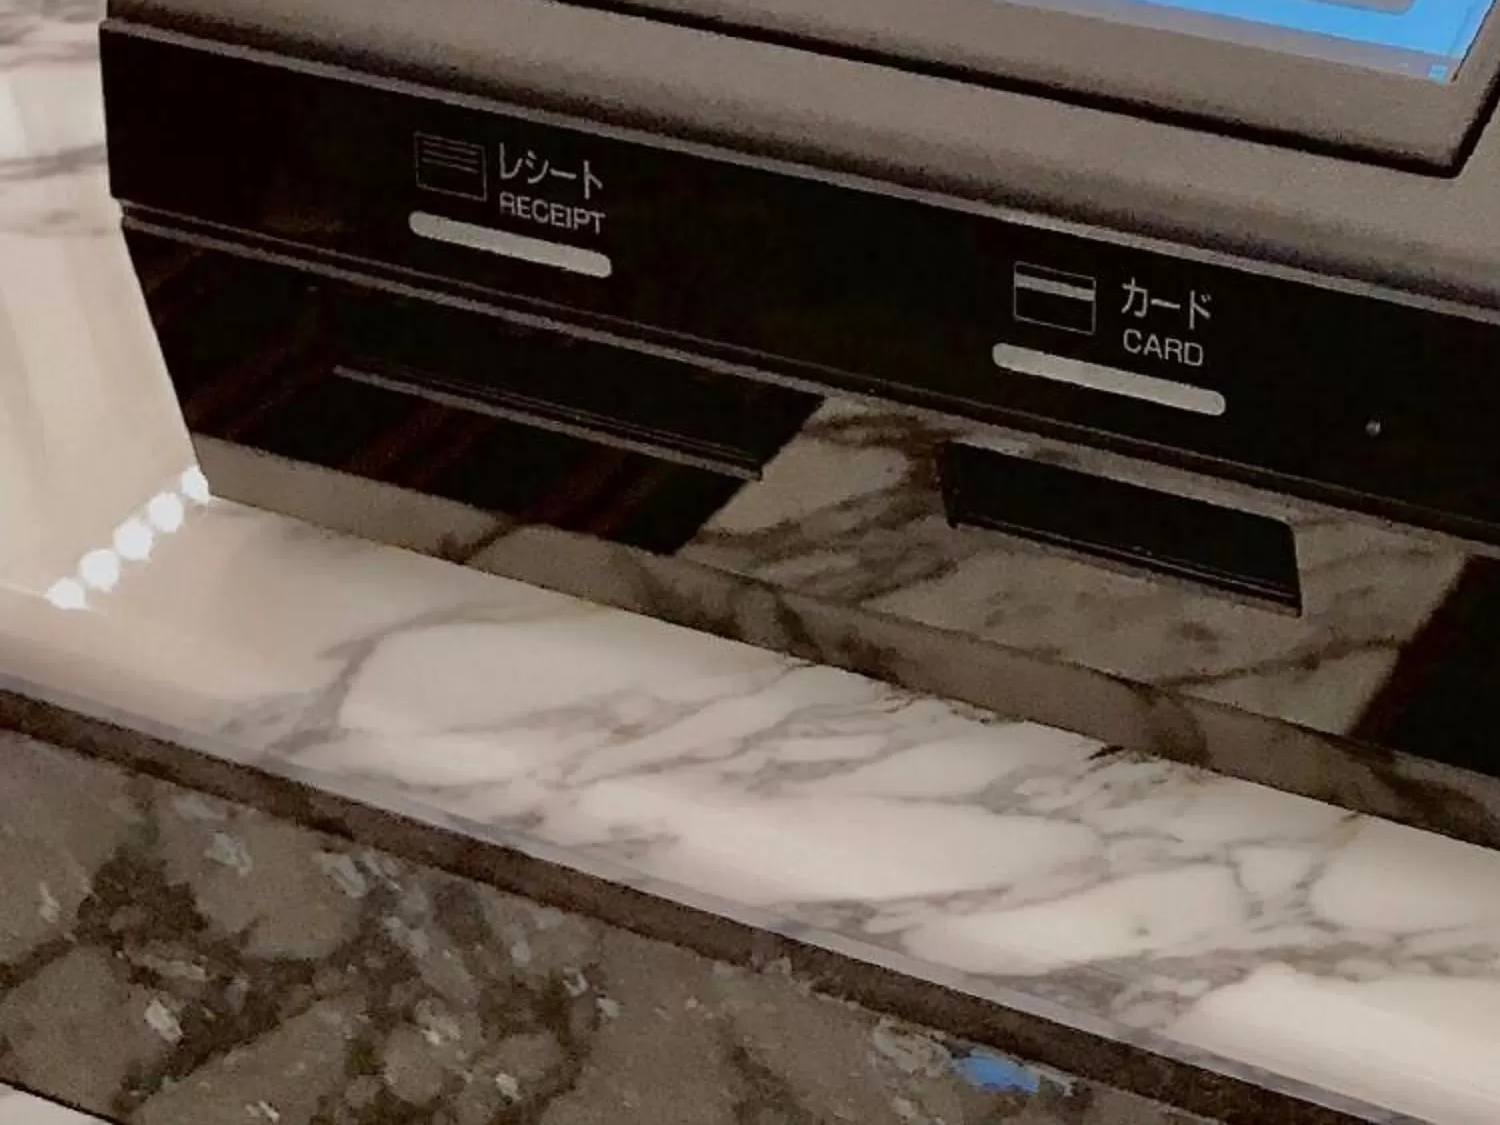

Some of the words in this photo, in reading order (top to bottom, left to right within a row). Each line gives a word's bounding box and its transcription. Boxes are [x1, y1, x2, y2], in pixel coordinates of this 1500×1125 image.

[499, 141, 604, 201] レシート
[499, 190, 607, 235] RECEIPT
[1121, 275, 1213, 331] カード
[1123, 328, 1205, 367] CARD
